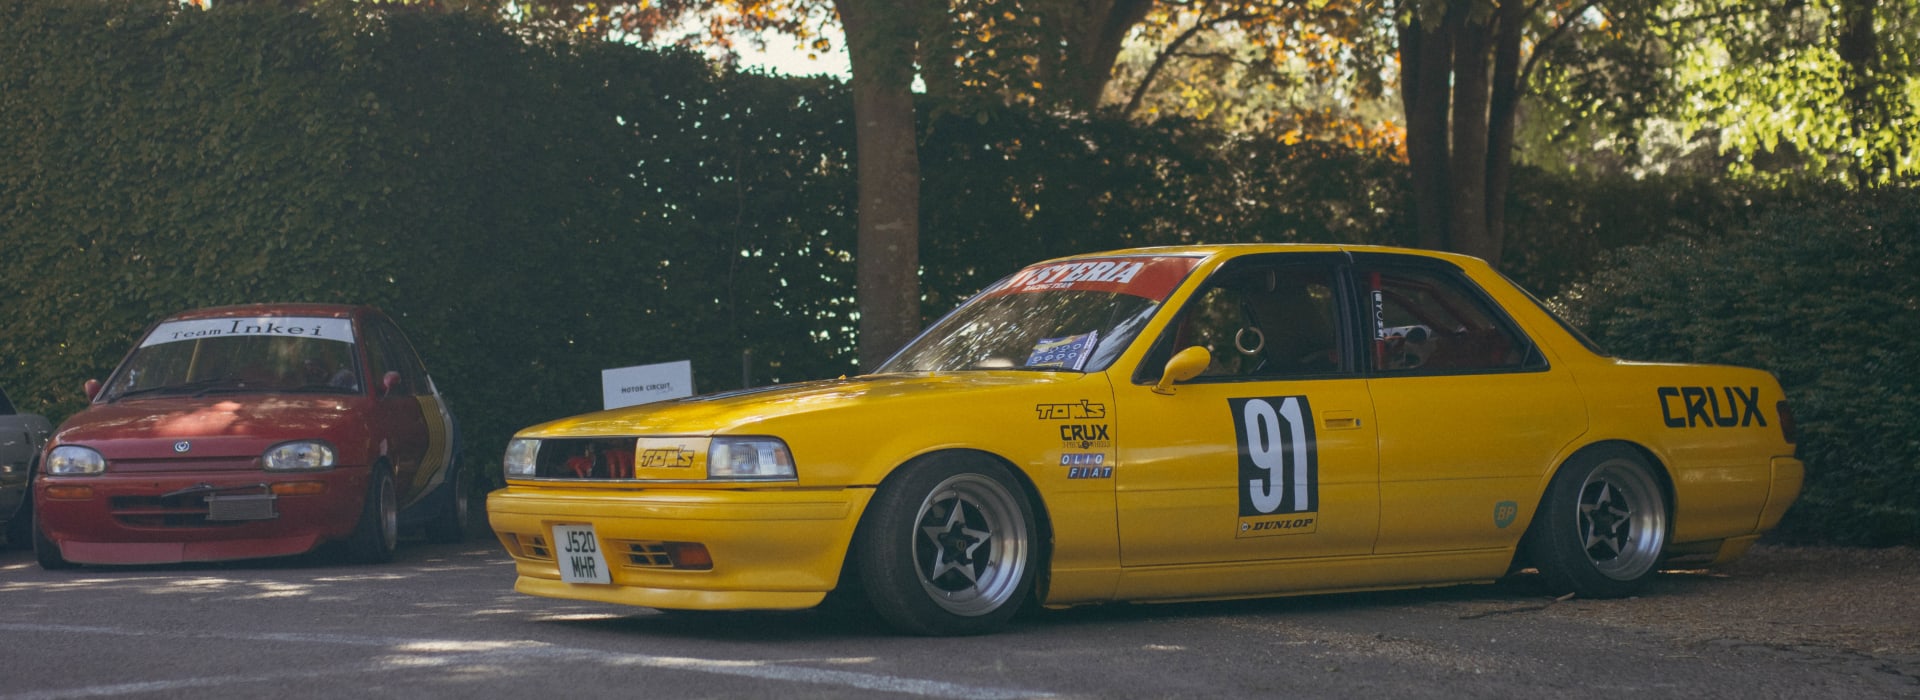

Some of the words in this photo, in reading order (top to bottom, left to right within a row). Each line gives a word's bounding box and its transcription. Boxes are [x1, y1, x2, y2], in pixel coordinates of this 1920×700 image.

[172, 329, 221, 340] Team
[226, 319, 323, 337] Inkei
[621, 385, 644, 394] MOTOR
[646, 382, 670, 391] CIRCUIT
[1658, 386, 1767, 428] CRUX
[1060, 424, 1110, 440] CRUX
[1061, 454, 1103, 465] OLIO
[1244, 397, 1308, 514] 91
[1069, 467, 1112, 478] FIAT
[1498, 506, 1514, 520] BP
[1252, 518, 1314, 531] DUNLOP
[565, 531, 596, 553] J520
[571, 555, 597, 578] MHR
